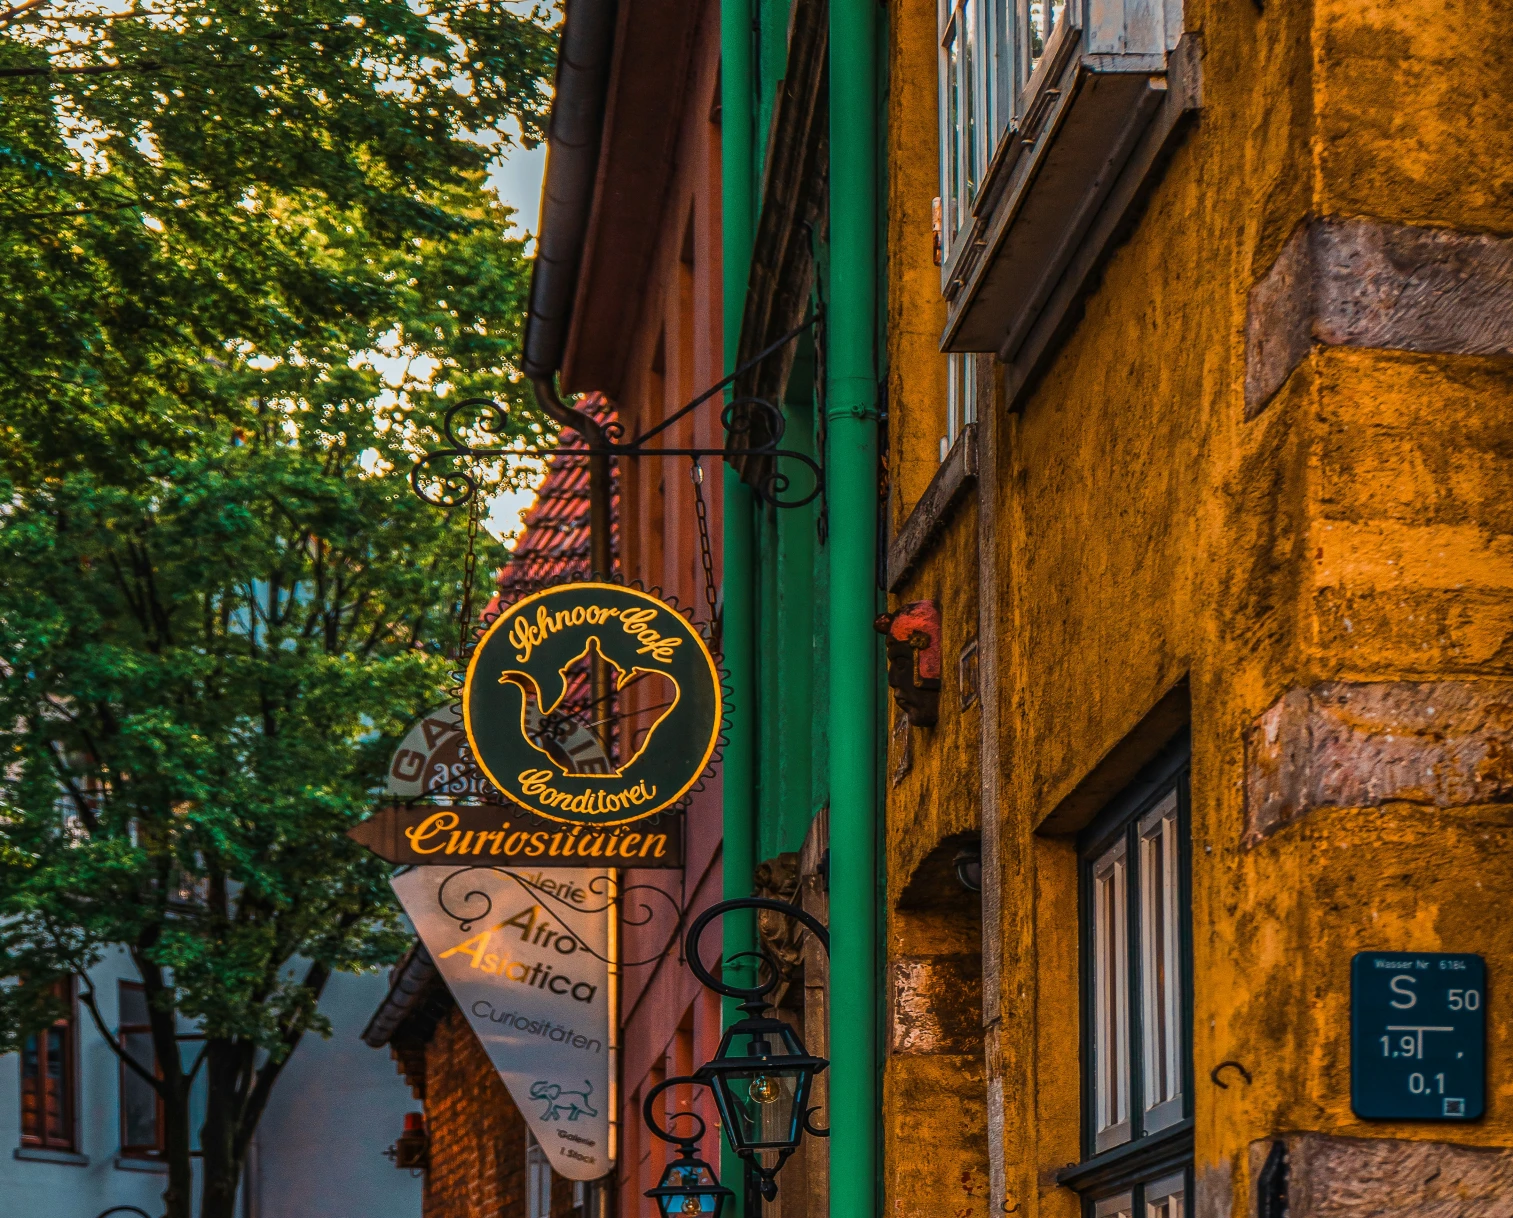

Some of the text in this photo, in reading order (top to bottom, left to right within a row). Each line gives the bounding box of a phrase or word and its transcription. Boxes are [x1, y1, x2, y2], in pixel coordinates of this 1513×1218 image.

[508, 605, 621, 663] Schnoor
[517, 768, 657, 815] Conditorei
[438, 931, 598, 1004] Asiatica
[1374, 959, 1413, 969] Wasser
[1389, 974, 1481, 1011] S 50
[471, 1000, 602, 1053] Curiositäten
[1408, 1072, 1446, 1095] 0,1
